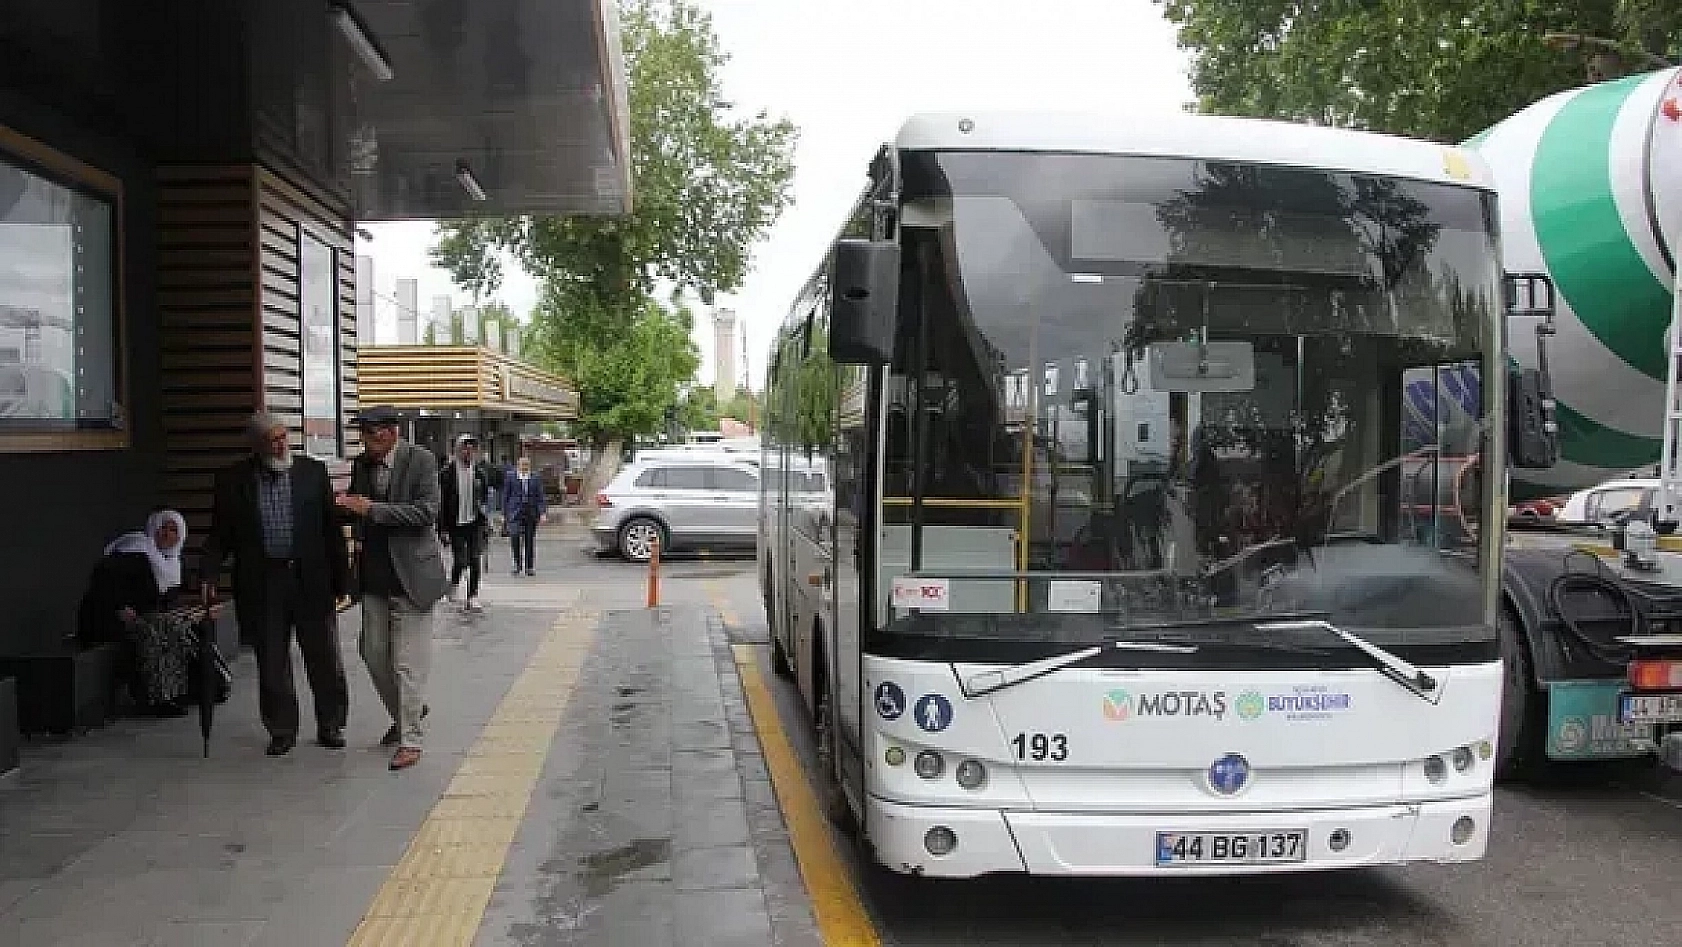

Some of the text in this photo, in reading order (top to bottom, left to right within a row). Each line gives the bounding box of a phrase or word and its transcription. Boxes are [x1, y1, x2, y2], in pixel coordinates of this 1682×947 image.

[1137, 691, 1226, 721] MOTAŞ
[1011, 733, 1068, 761] 193
[1172, 833, 1301, 860] 44 BG 137
